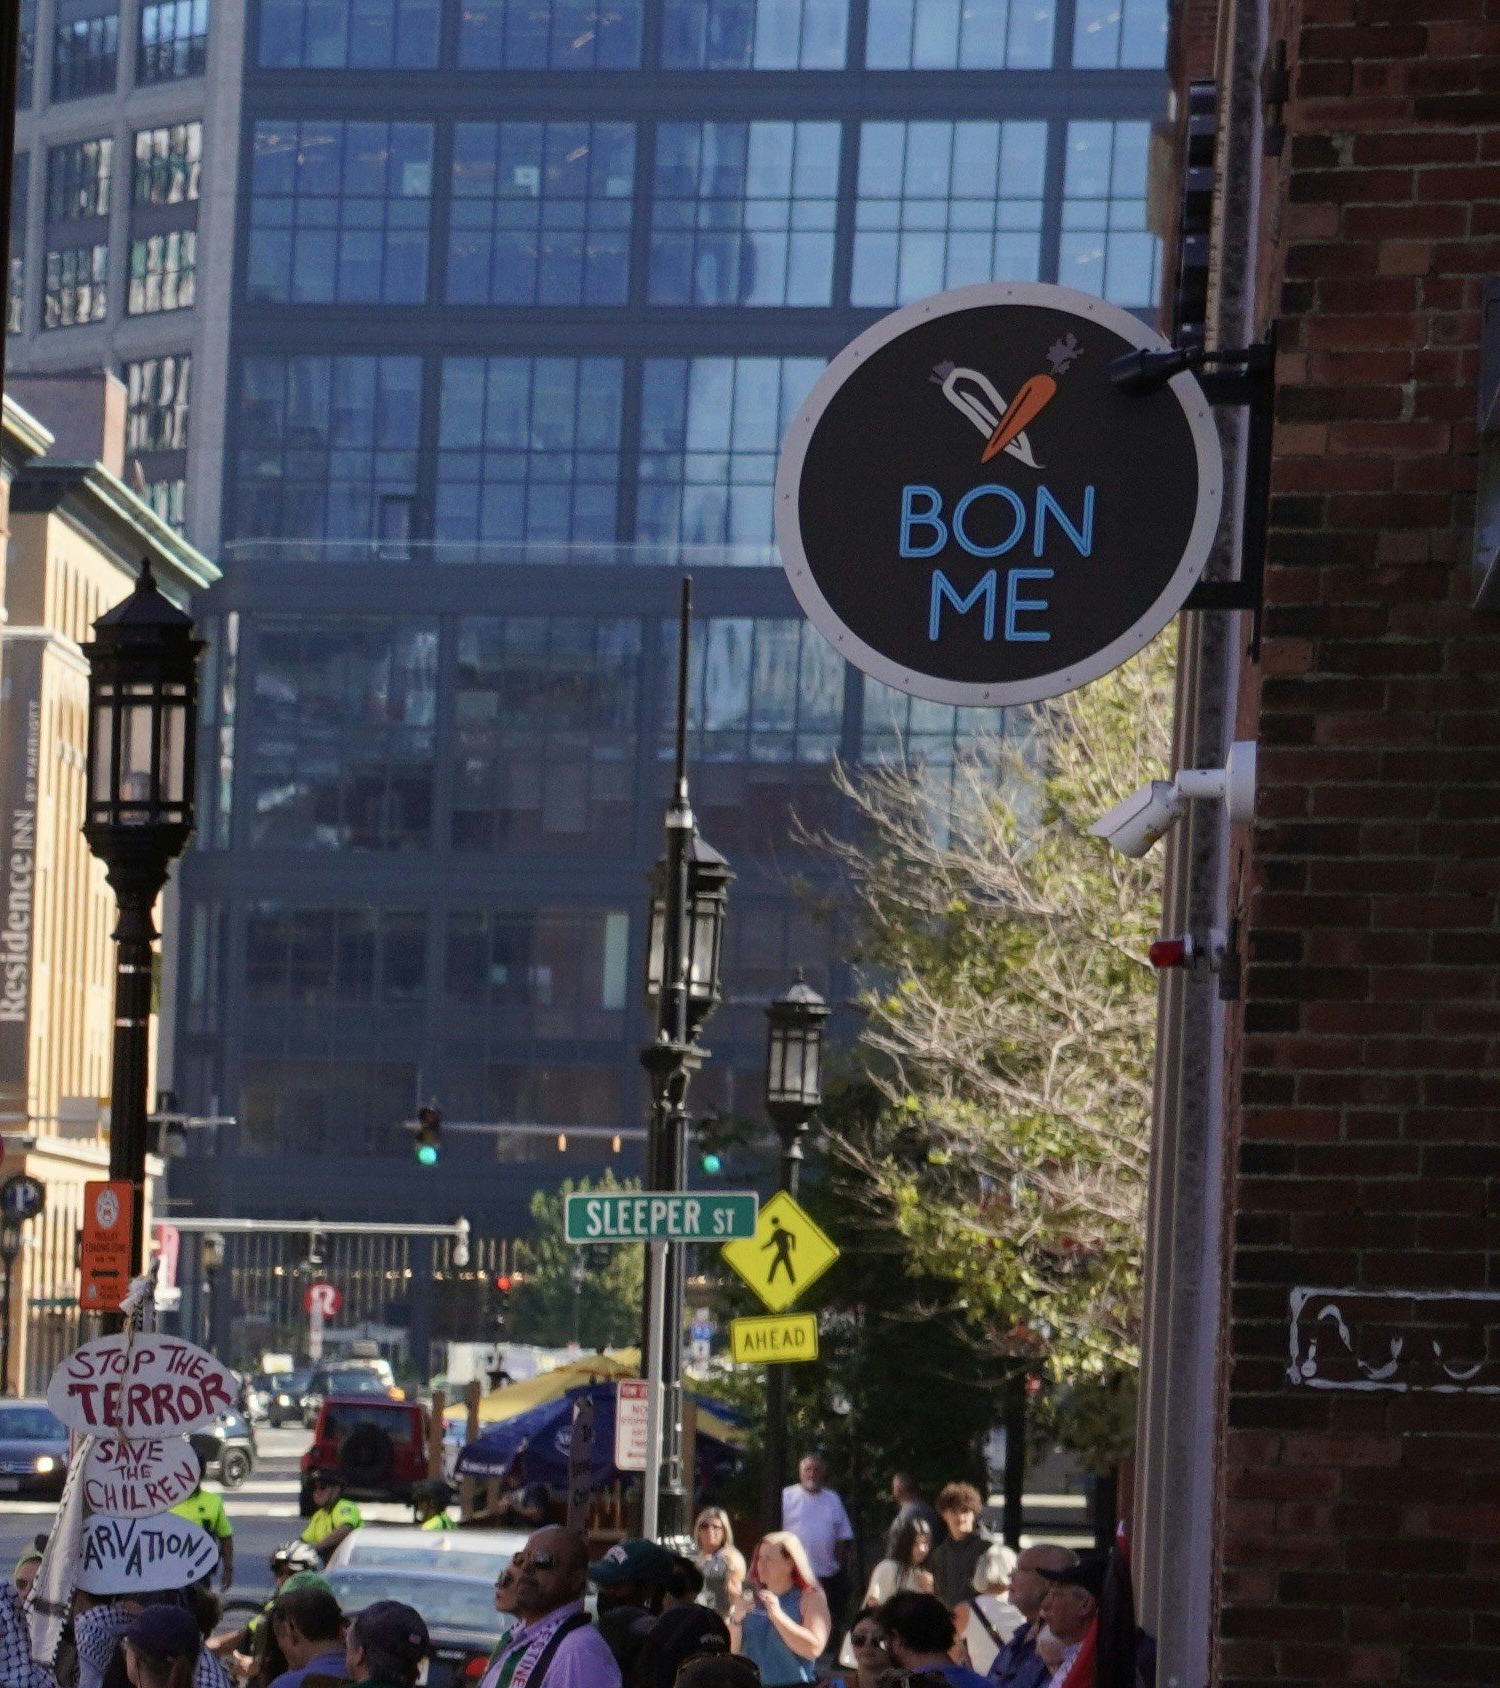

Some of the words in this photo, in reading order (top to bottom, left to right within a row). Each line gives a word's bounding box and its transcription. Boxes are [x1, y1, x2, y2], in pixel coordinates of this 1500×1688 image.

[898, 483, 1095, 560] BON
[929, 567, 1054, 644] ME
[11, 810, 34, 849] INN
[586, 1198, 700, 1236] SLEEPER
[713, 1208, 735, 1234] ST
[744, 1329, 806, 1351] AHEAD
[68, 1348, 155, 1380] STOP
[159, 1344, 209, 1380] THE
[67, 1373, 232, 1427] TERROR
[95, 1440, 163, 1464] SAVE
[85, 1461, 196, 1511] CHILREN
[109, 1464, 152, 1481] THE
[80, 1518, 212, 1579] ARVATION!
